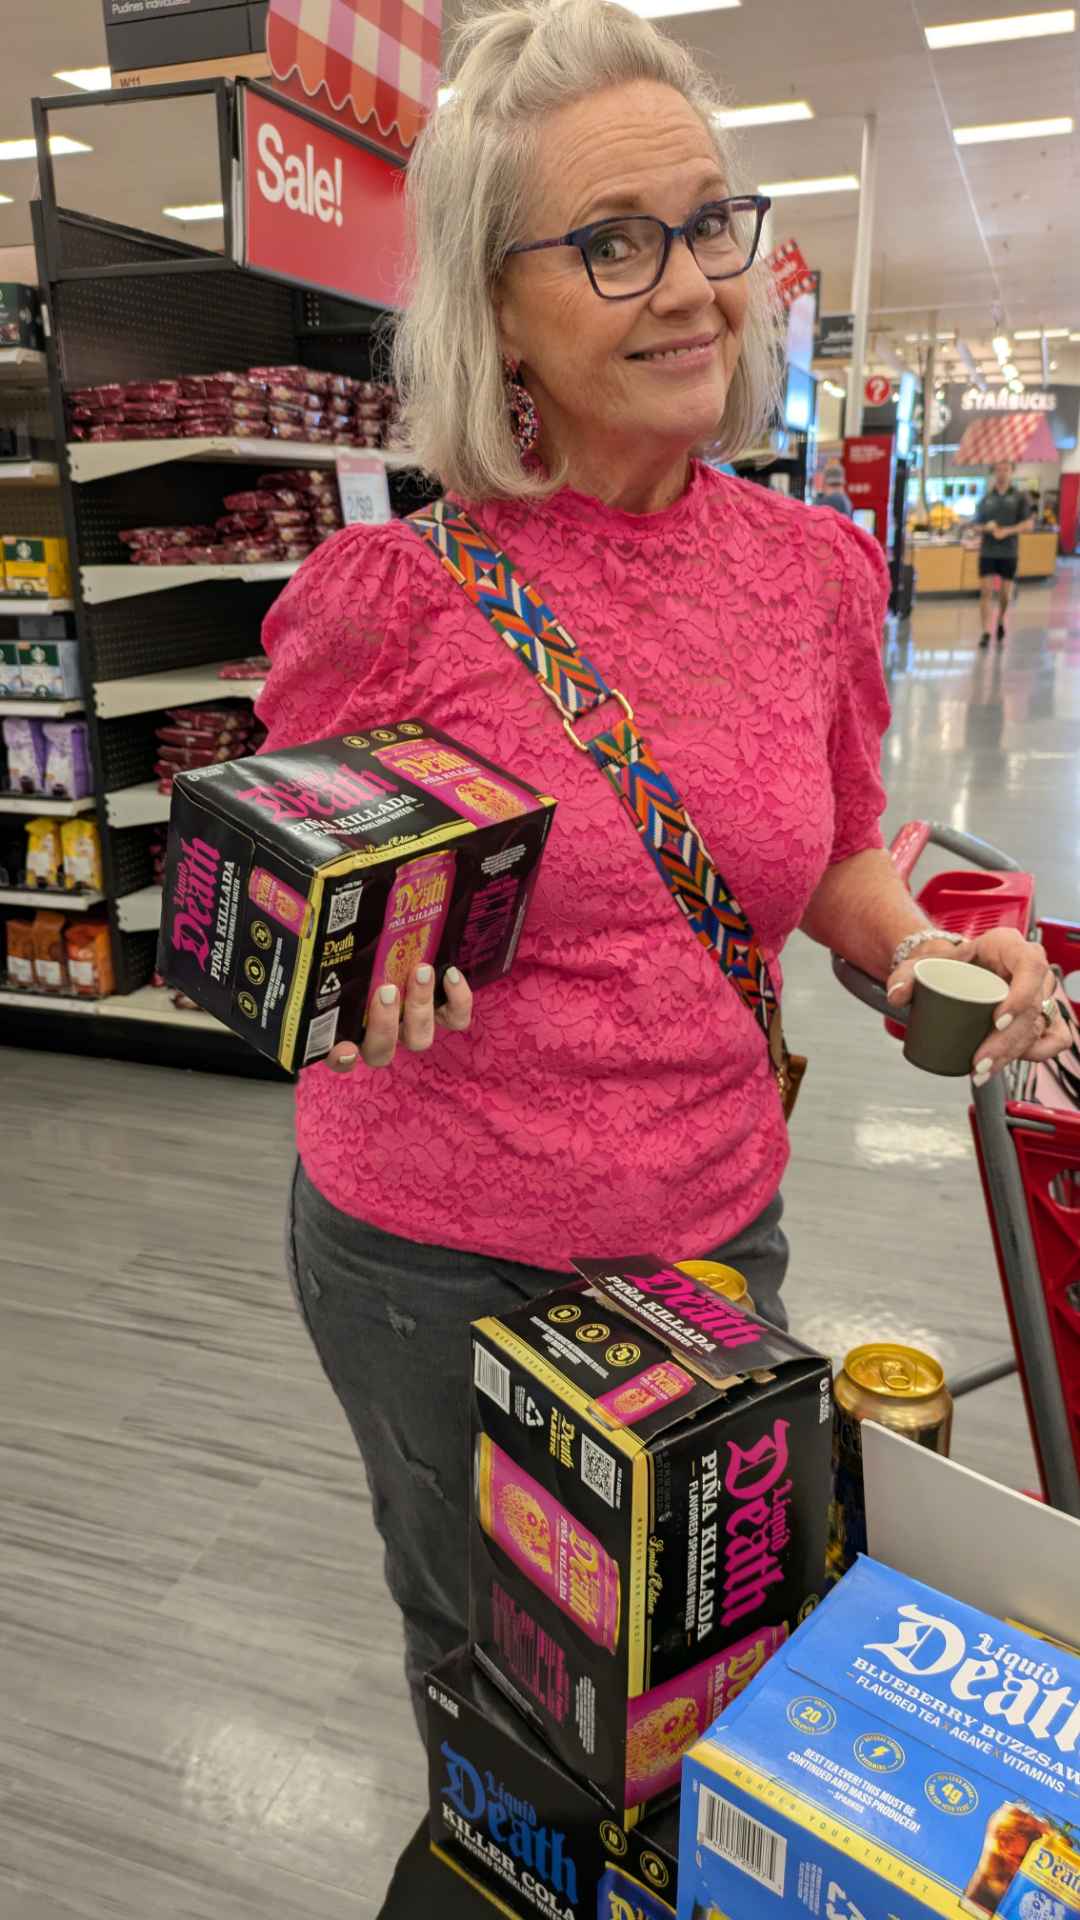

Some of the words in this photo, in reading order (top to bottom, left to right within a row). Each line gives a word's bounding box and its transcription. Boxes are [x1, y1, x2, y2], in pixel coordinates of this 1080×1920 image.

[257, 123, 344, 228] Sale!
[961, 388, 1056, 411] STARBUCKS
[236, 763, 400, 824] Death
[333, 793, 418, 829] KILLADA
[171, 838, 220, 972] Death
[216, 861, 235, 939] KILLADA
[210, 941, 225, 981] PIÑA
[623, 1270, 768, 1348] Death
[644, 1300, 717, 1352] KILLADA
[687, 1480, 699, 1536] FLAVORED
[701, 1450, 721, 1522] PIÑA
[771, 1479, 793, 1552] Liquid
[720, 1418, 791, 1627] Death
[568, 1526, 599, 1628] Death
[687, 1536, 698, 1597] SPARKLING
[697, 1523, 718, 1642] KILLADA
[852, 1657, 978, 1728] BLUEBERRY
[973, 1633, 1060, 1686] Liquid
[800, 1706, 822, 1723] 20
[856, 1675, 918, 1713] FLAVORED
[917, 1706, 941, 1727] TEA
[950, 1726, 994, 1754] AGAVE
[1003, 1752, 1066, 1793] VITAMINS
[485, 1770, 537, 1826] Liquid
[787, 1751, 833, 1782] CONTINUED
[872, 1799, 920, 1833] PRODUCED!
[803, 1748, 824, 1764] BEST
[880, 1790, 905, 1810] MUST
[942, 1783, 963, 1804] 4g
[441, 1741, 578, 1905] Death
[808, 1815, 850, 1845] YOUR
[863, 1847, 930, 1893] THIRST
[442, 1801, 515, 1875] KILLER
[521, 1872, 575, 1920] COLA
